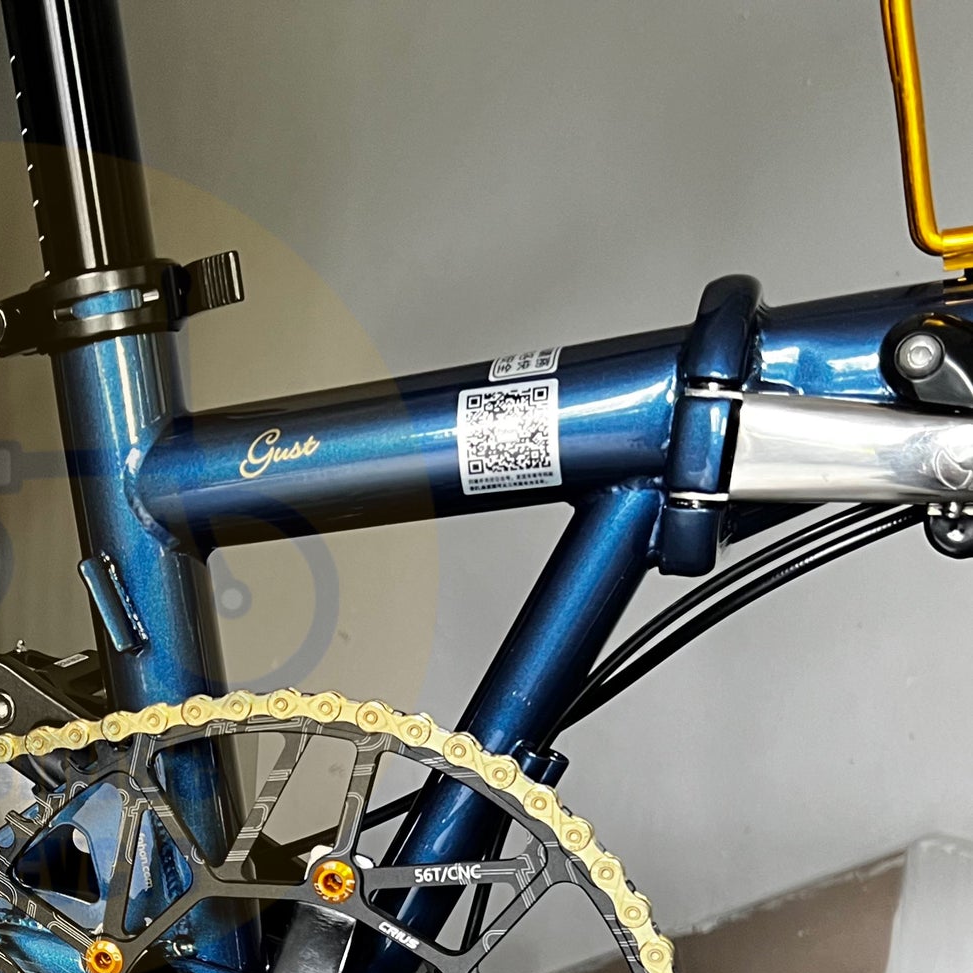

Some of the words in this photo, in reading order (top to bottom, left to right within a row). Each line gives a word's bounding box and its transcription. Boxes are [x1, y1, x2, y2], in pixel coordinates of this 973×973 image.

[239, 428, 320, 479] Gust
[414, 863, 483, 884] 56T/CNC
[378, 921, 420, 949] CRIUS
